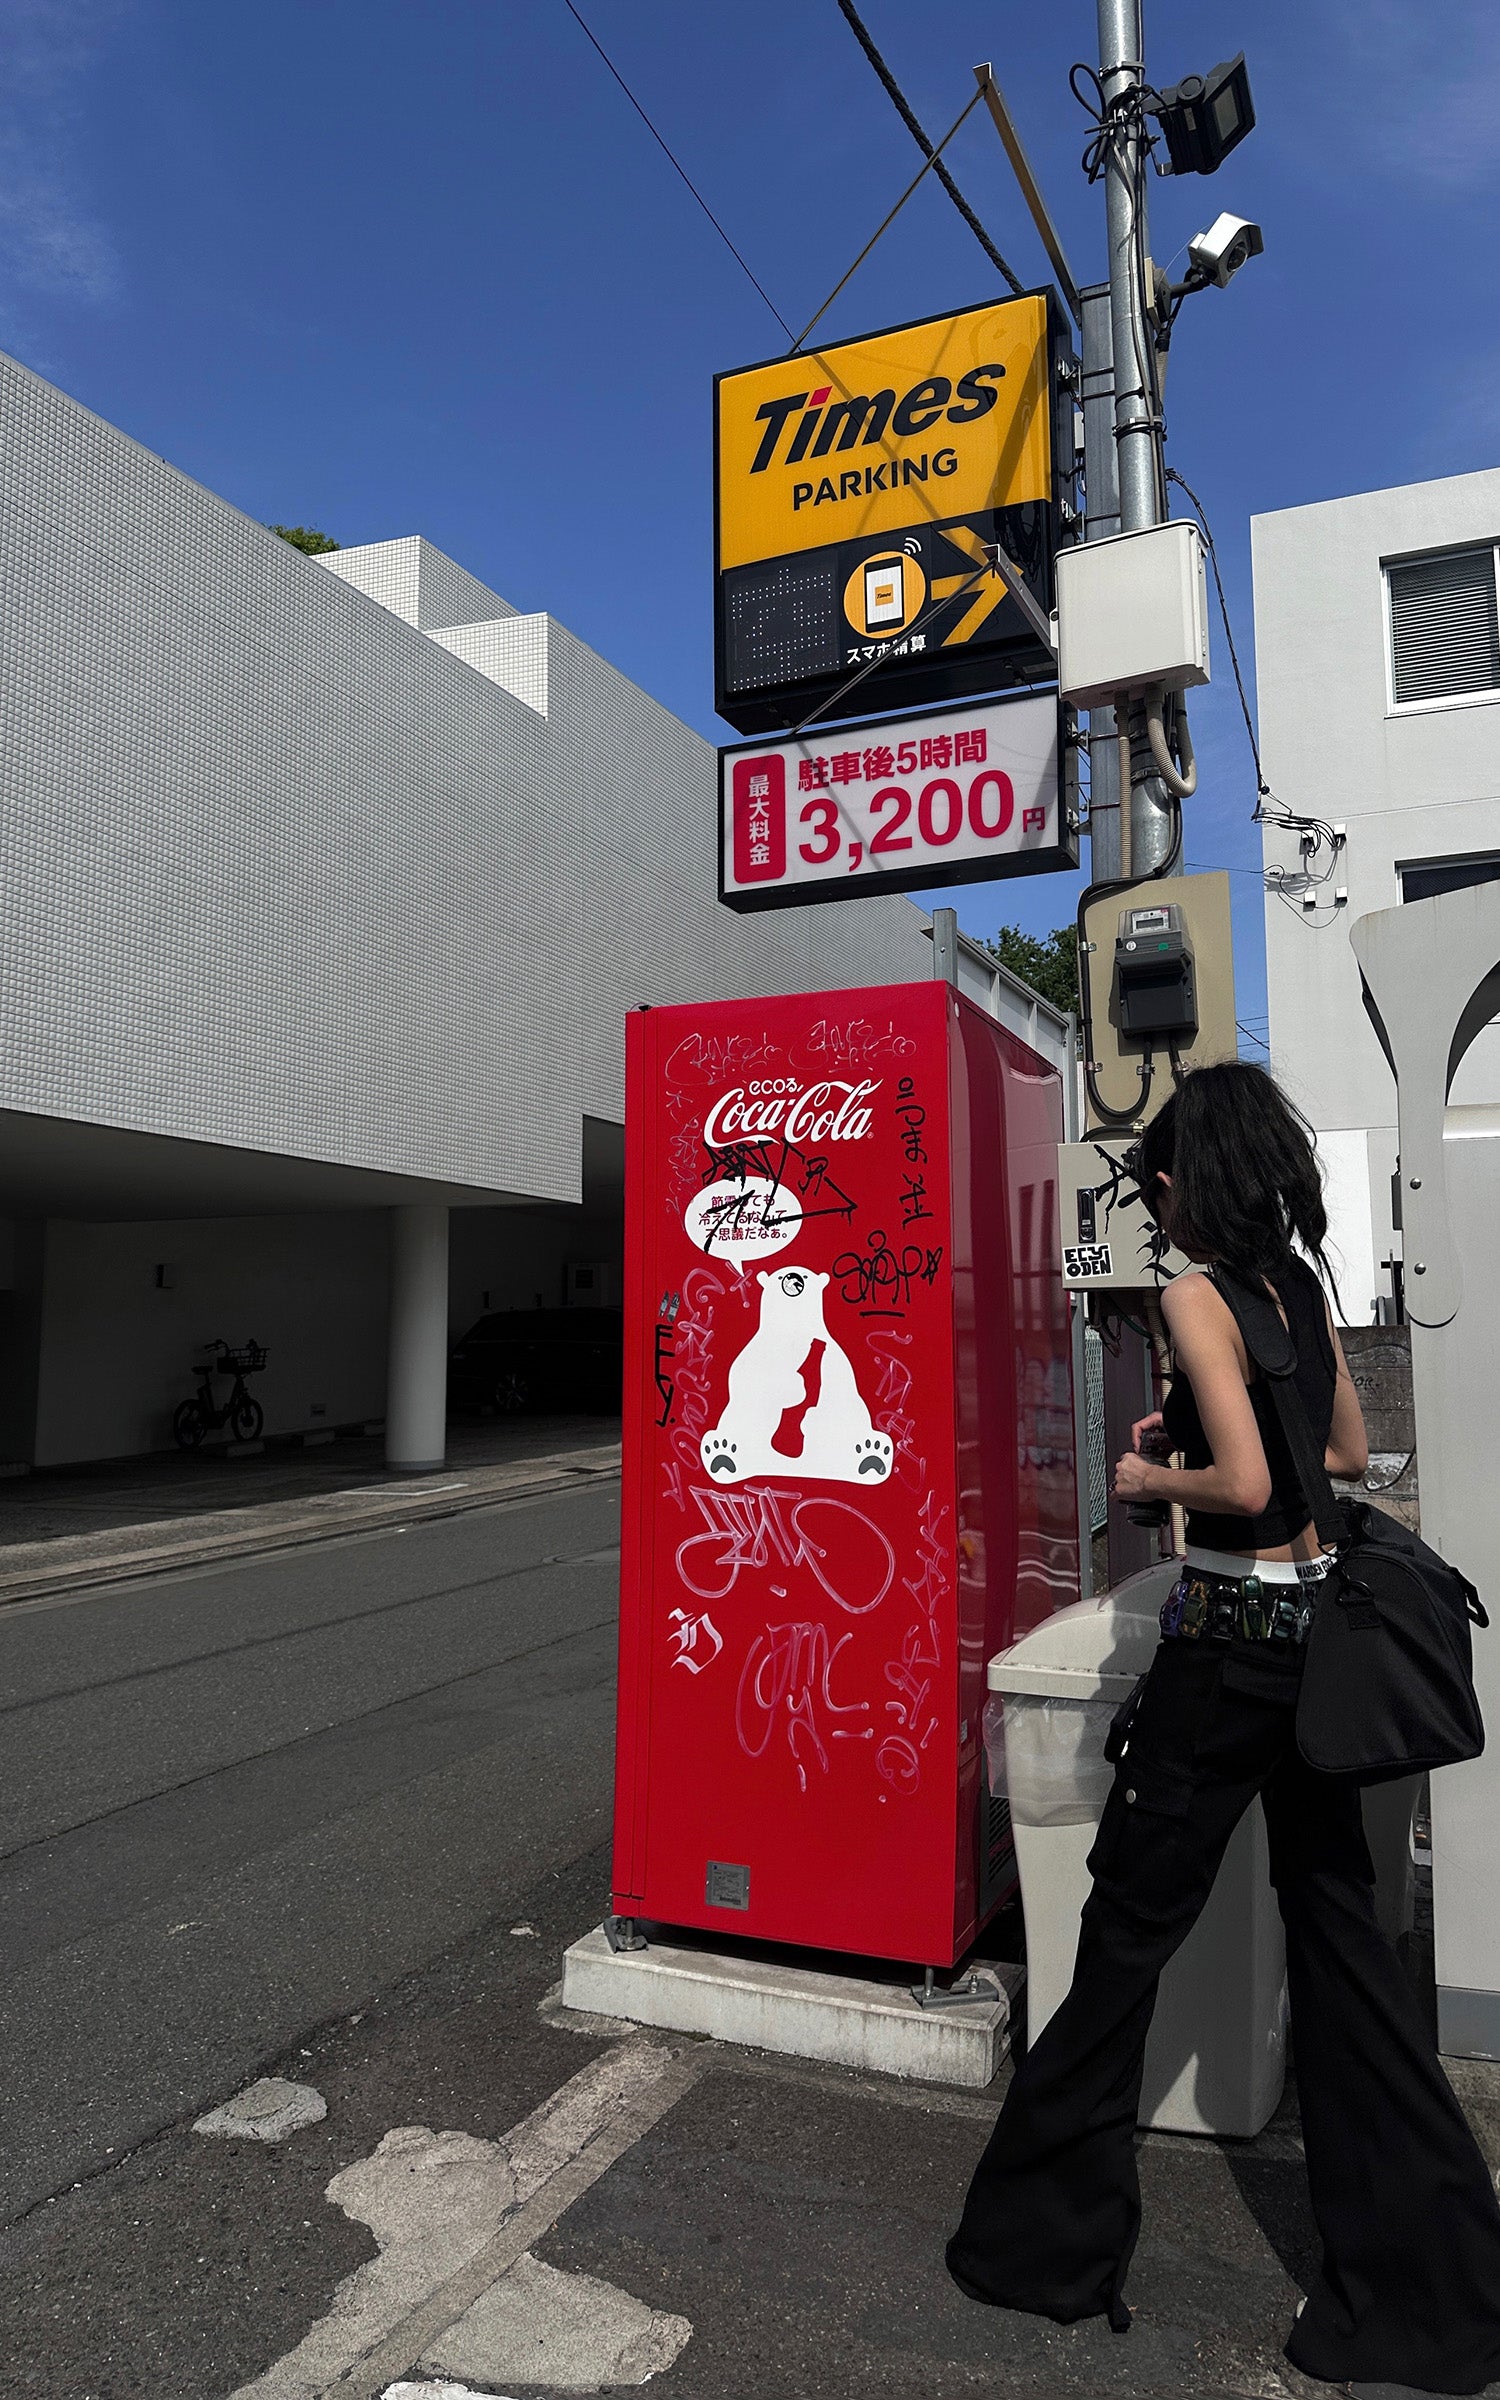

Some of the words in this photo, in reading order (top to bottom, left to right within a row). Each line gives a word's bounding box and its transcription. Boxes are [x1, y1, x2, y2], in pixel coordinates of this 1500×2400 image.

[749, 363, 1006, 474] Times
[793, 447, 958, 511] PARKING
[797, 728, 988, 792] 駐車後5時間
[748, 774, 770, 867] 最大料金
[703, 1078, 884, 1148] Coca-Cola
[1066, 1250, 1112, 1277] ODEN
